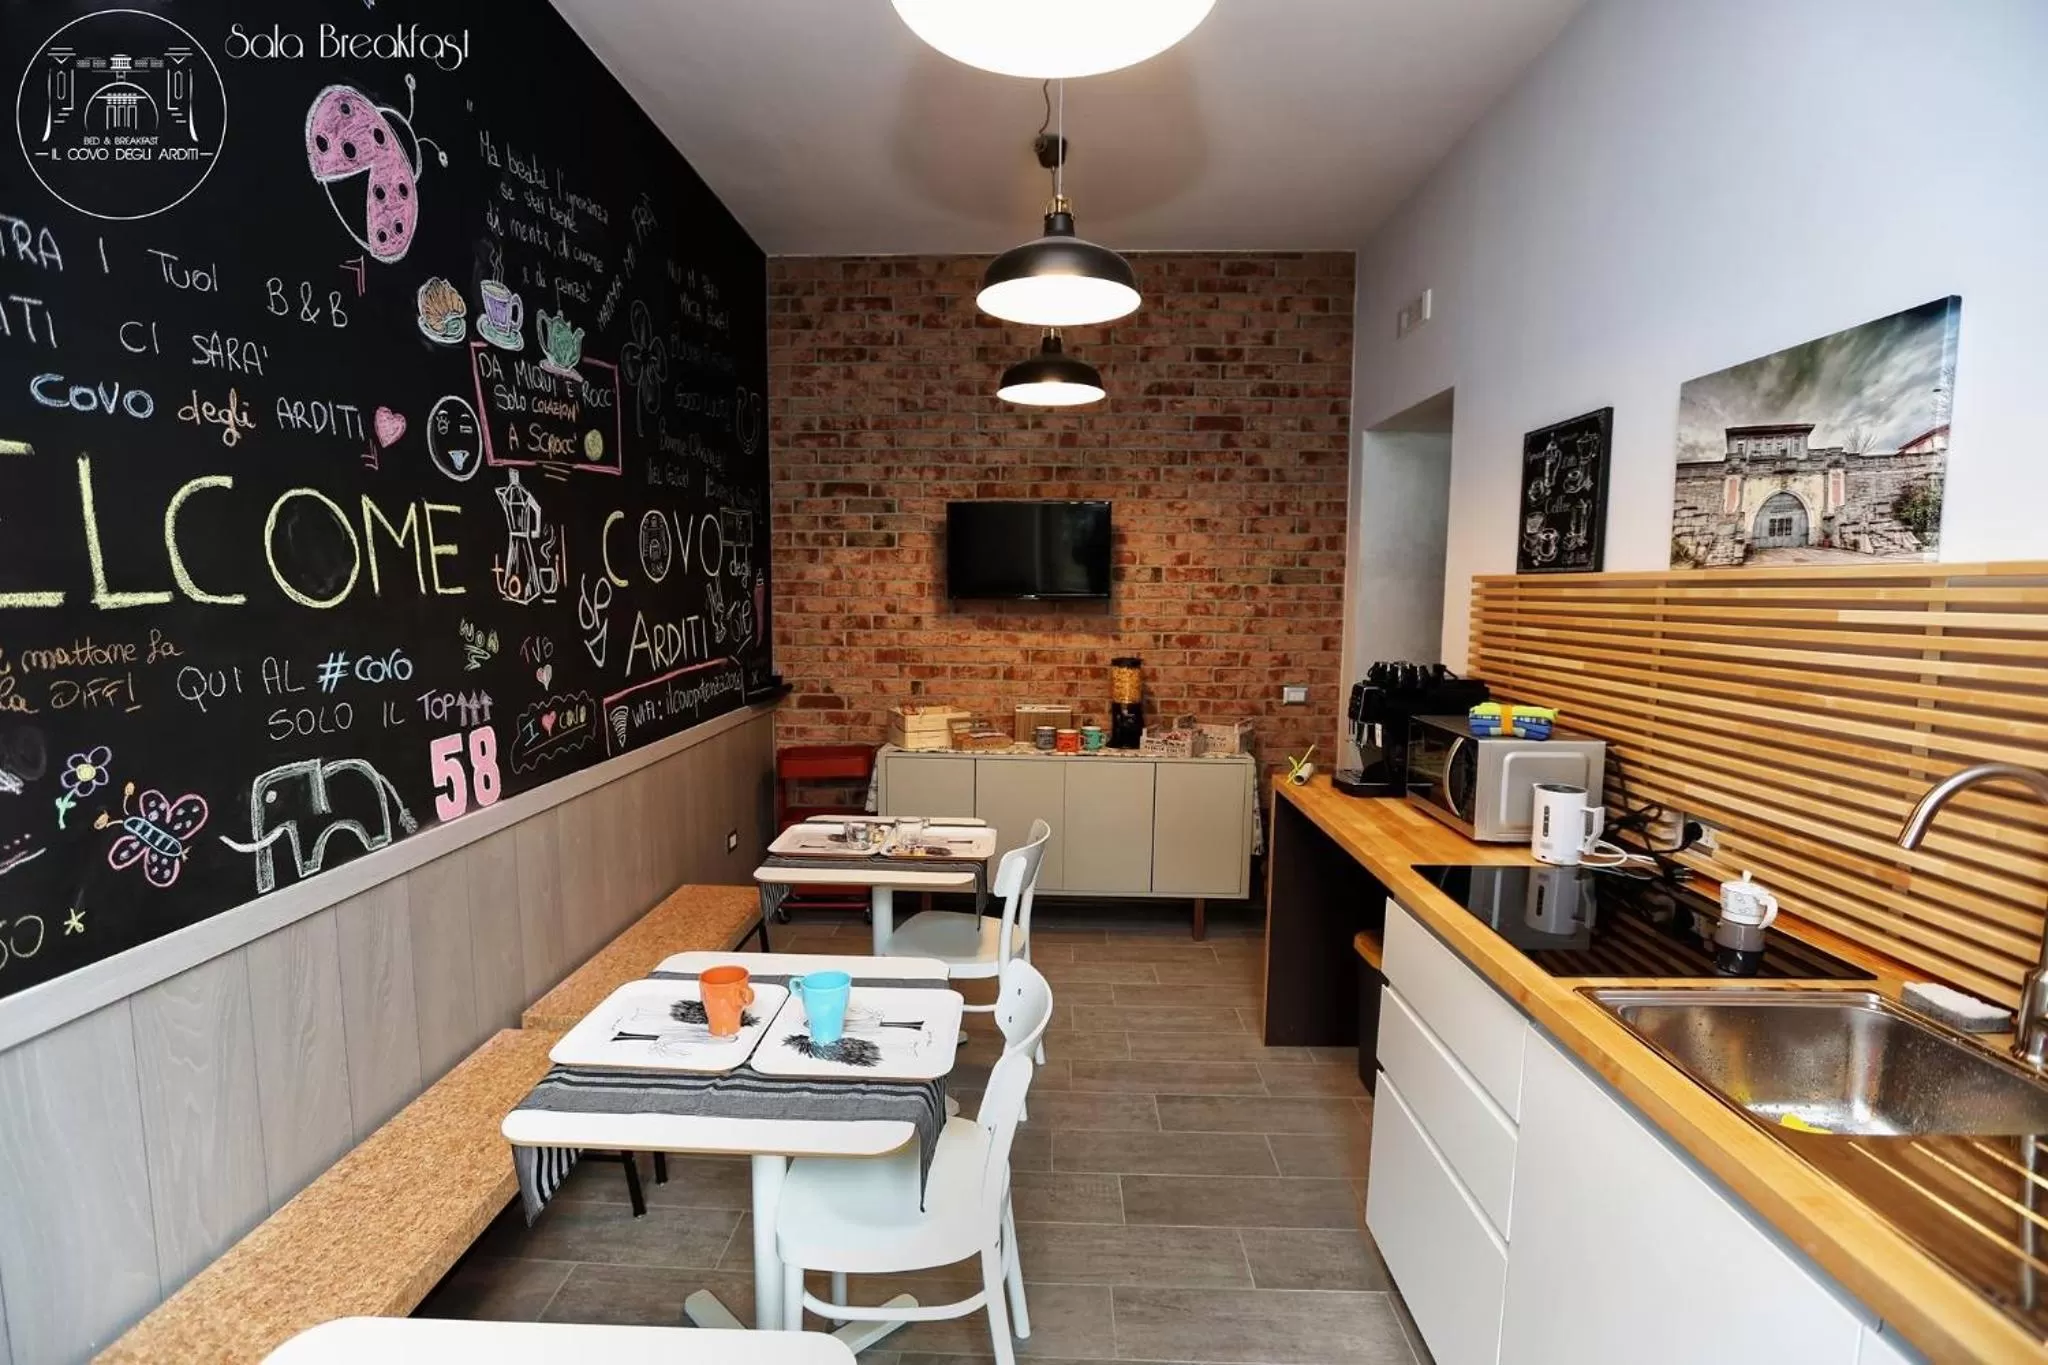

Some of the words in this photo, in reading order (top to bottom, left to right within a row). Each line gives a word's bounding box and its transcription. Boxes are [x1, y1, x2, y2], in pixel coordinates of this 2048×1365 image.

[265, 277, 289, 315] B
[299, 281, 320, 324] &
[328, 290, 348, 327] B
[119, 321, 160, 355] CI
[177, 387, 257, 447] degli
[277, 396, 366, 440] ARDITI
[508, 421, 520, 452] A
[624, 609, 709, 677] ARDITI
[177, 665, 242, 713] QUI
[262, 656, 306, 695] AL
[267, 702, 353, 741] SOLO
[383, 700, 406, 728] IL
[416, 688, 456, 722] TOP
[430, 724, 502, 823] 58
